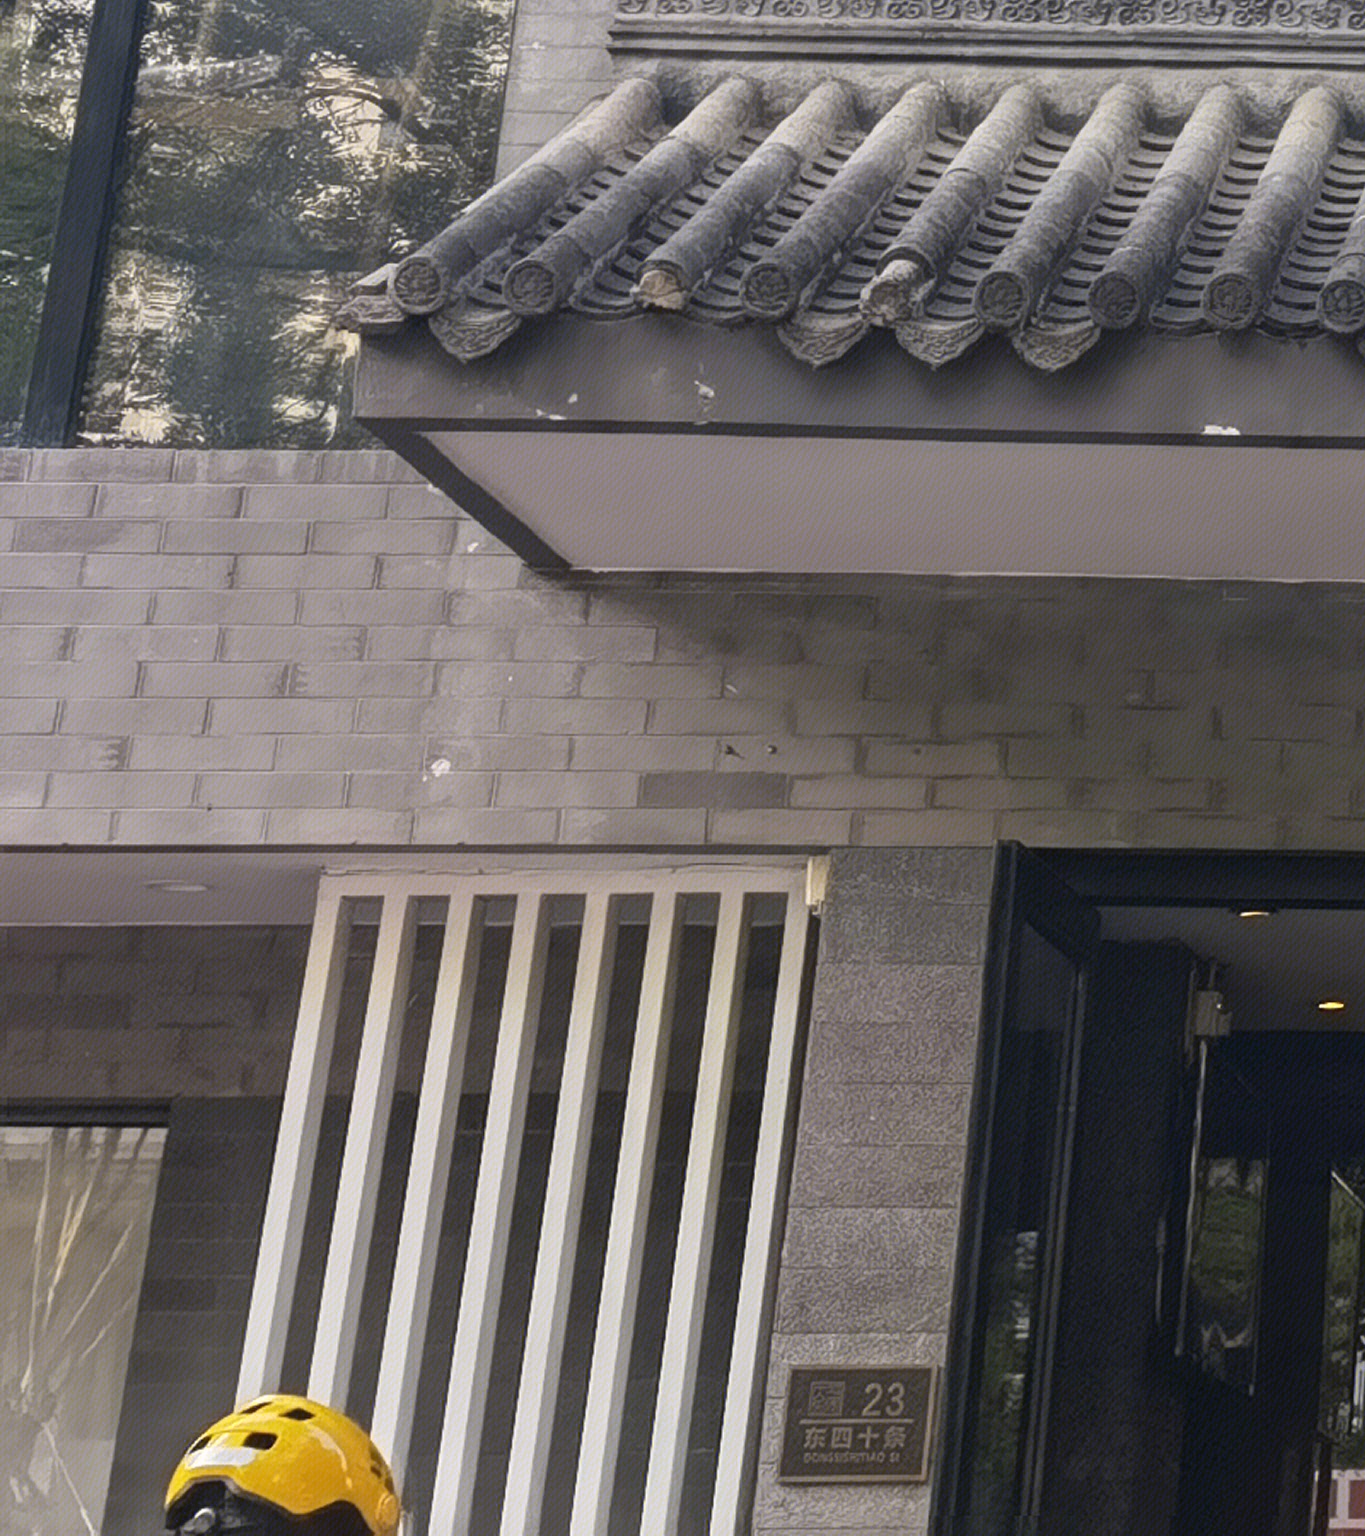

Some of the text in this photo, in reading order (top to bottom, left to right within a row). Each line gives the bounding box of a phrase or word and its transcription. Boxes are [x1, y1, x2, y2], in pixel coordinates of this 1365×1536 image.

[861, 1381, 906, 1417] 23
[803, 1425, 906, 1450] 东四十条
